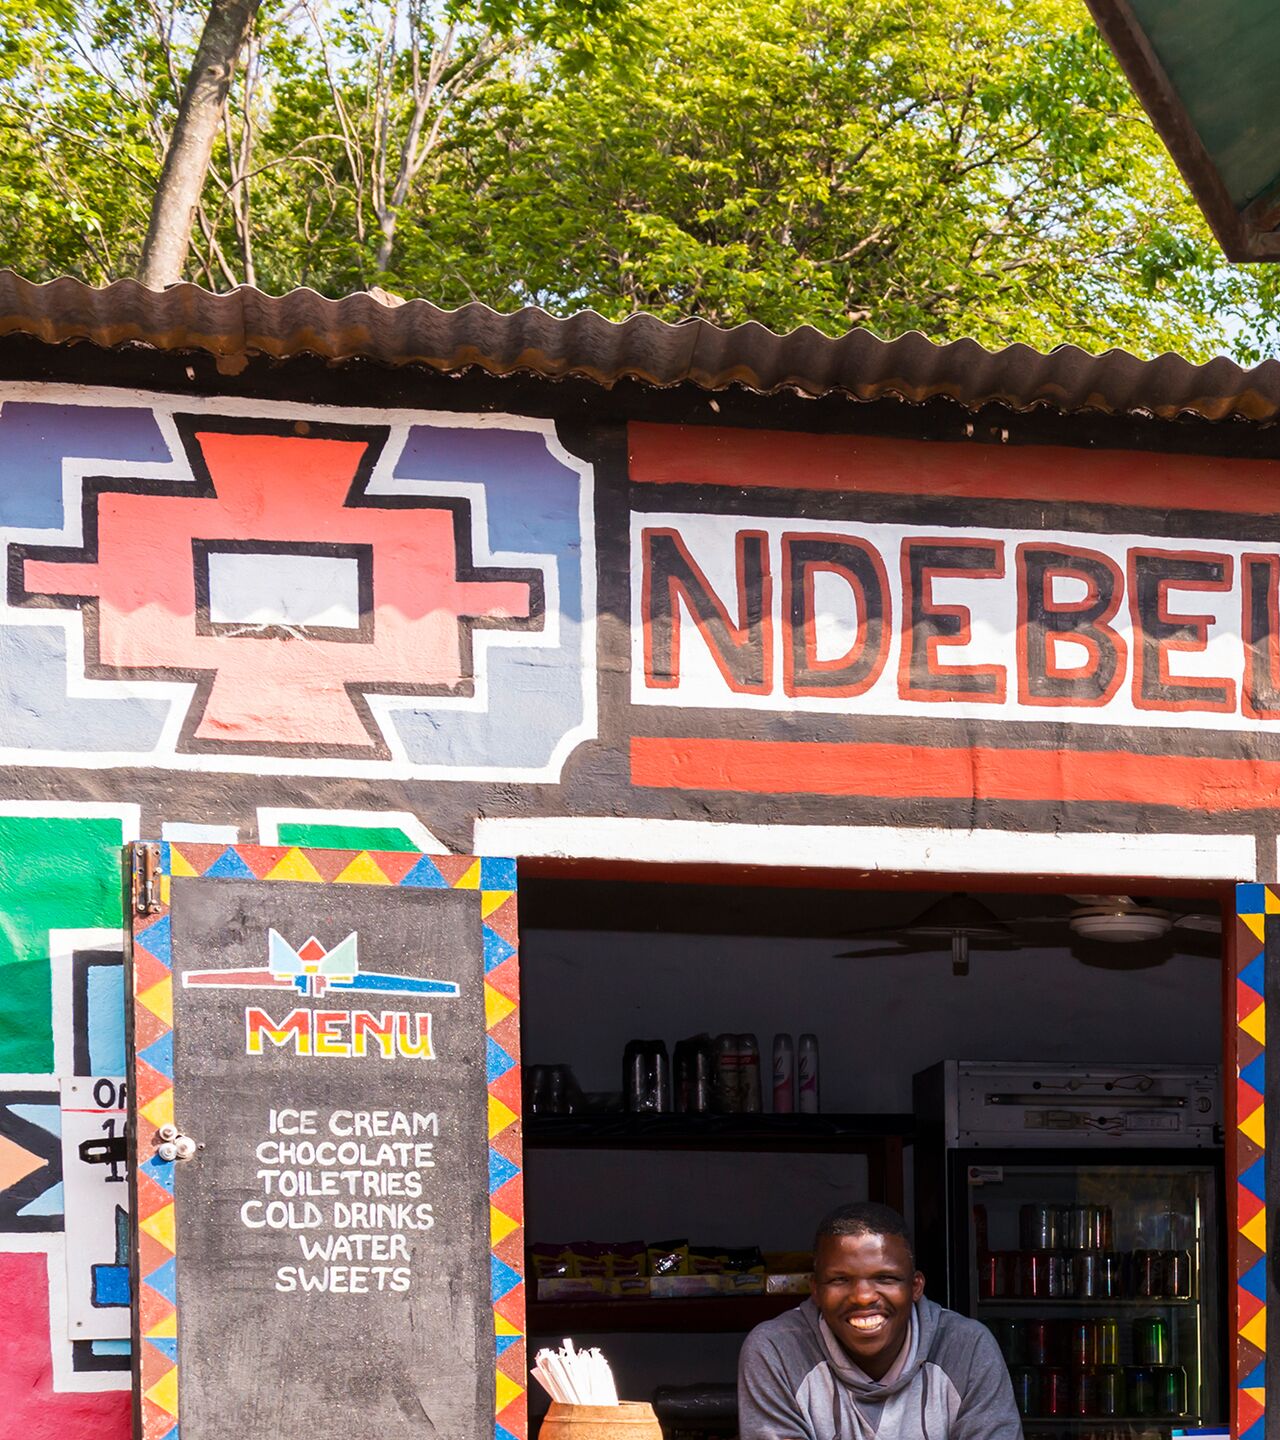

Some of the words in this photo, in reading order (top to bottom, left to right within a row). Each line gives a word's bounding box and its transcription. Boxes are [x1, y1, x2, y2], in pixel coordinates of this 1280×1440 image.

[245, 1007, 436, 1060] MENU
[269, 1109, 318, 1135] ICE
[329, 1110, 438, 1137] CREAM
[256, 1141, 435, 1167] CHOCOLATE
[257, 1170, 422, 1197] TOILETRIES
[241, 1200, 323, 1229] COLD
[334, 1202, 435, 1230] DRINKS
[299, 1234, 411, 1261] WATER
[275, 1266, 411, 1293] SWEETS
